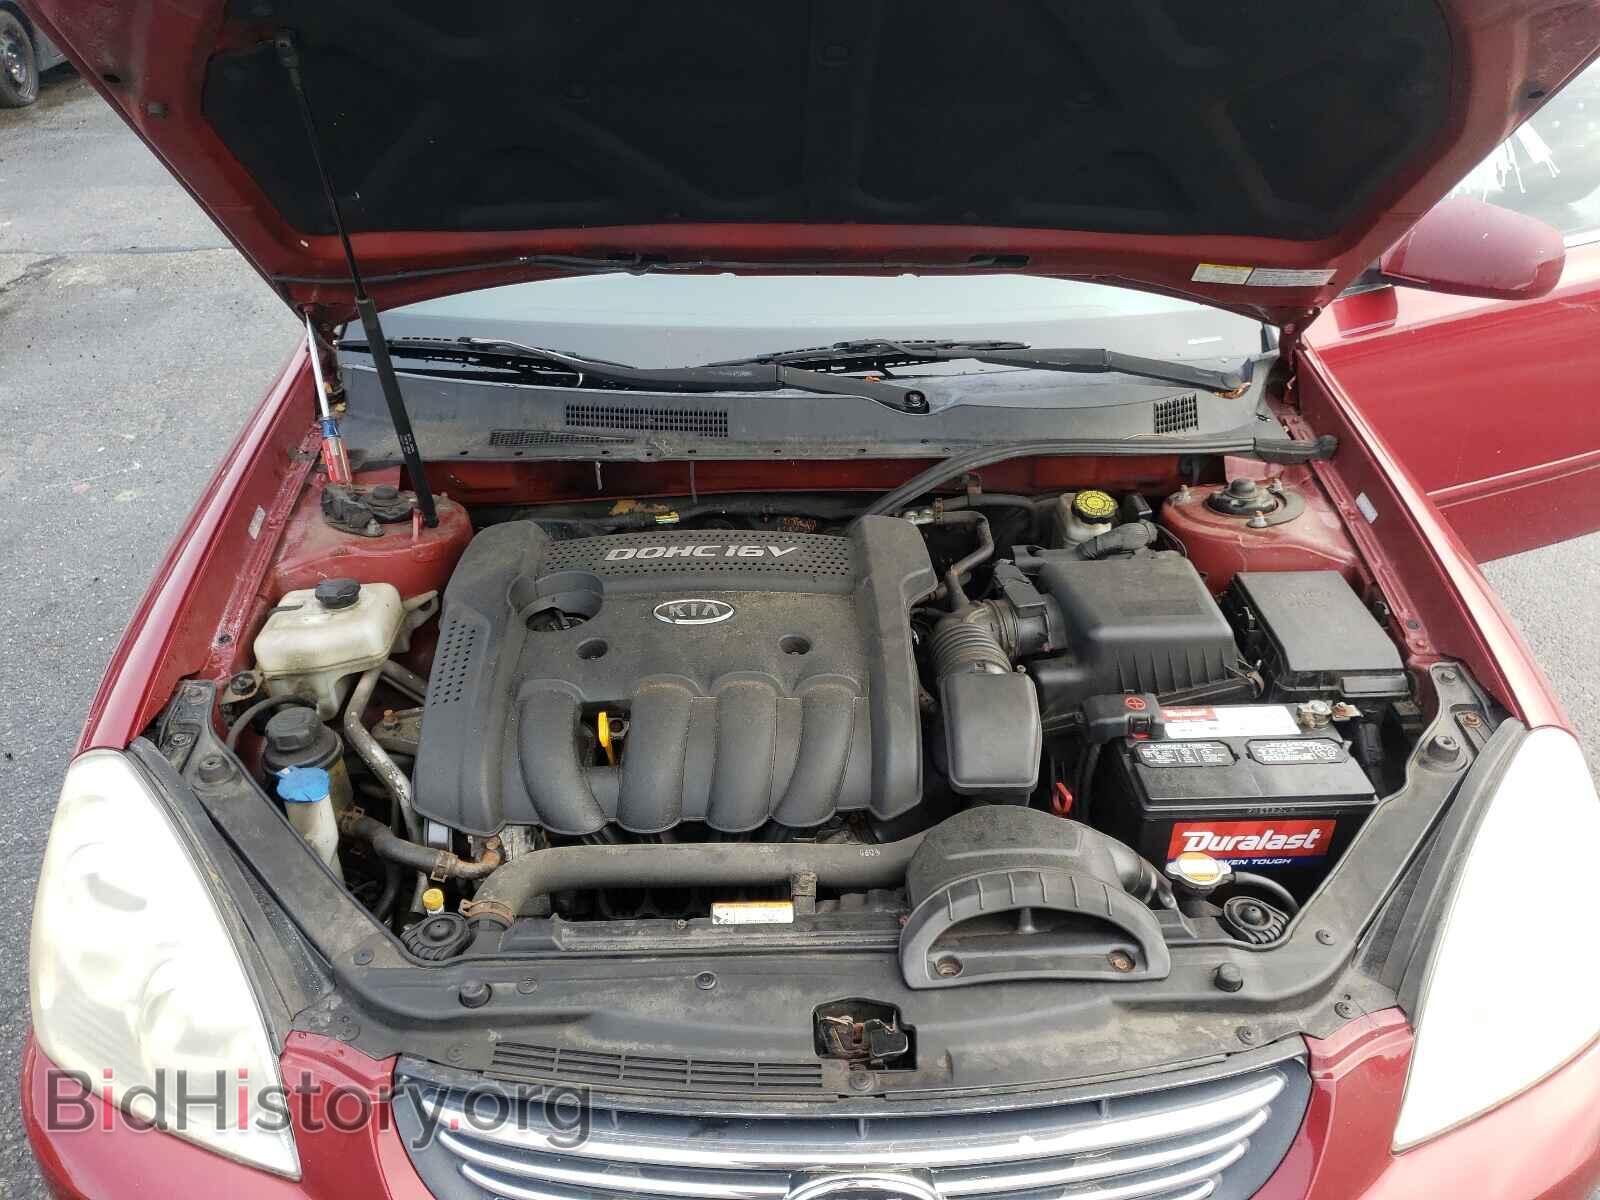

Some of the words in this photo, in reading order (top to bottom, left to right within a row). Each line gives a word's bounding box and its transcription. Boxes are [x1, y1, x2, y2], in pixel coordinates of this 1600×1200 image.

[604, 545, 722, 561] DOHC
[724, 544, 799, 558] 16V
[668, 603, 720, 617] KIA
[1182, 828, 1321, 852] Duralast
